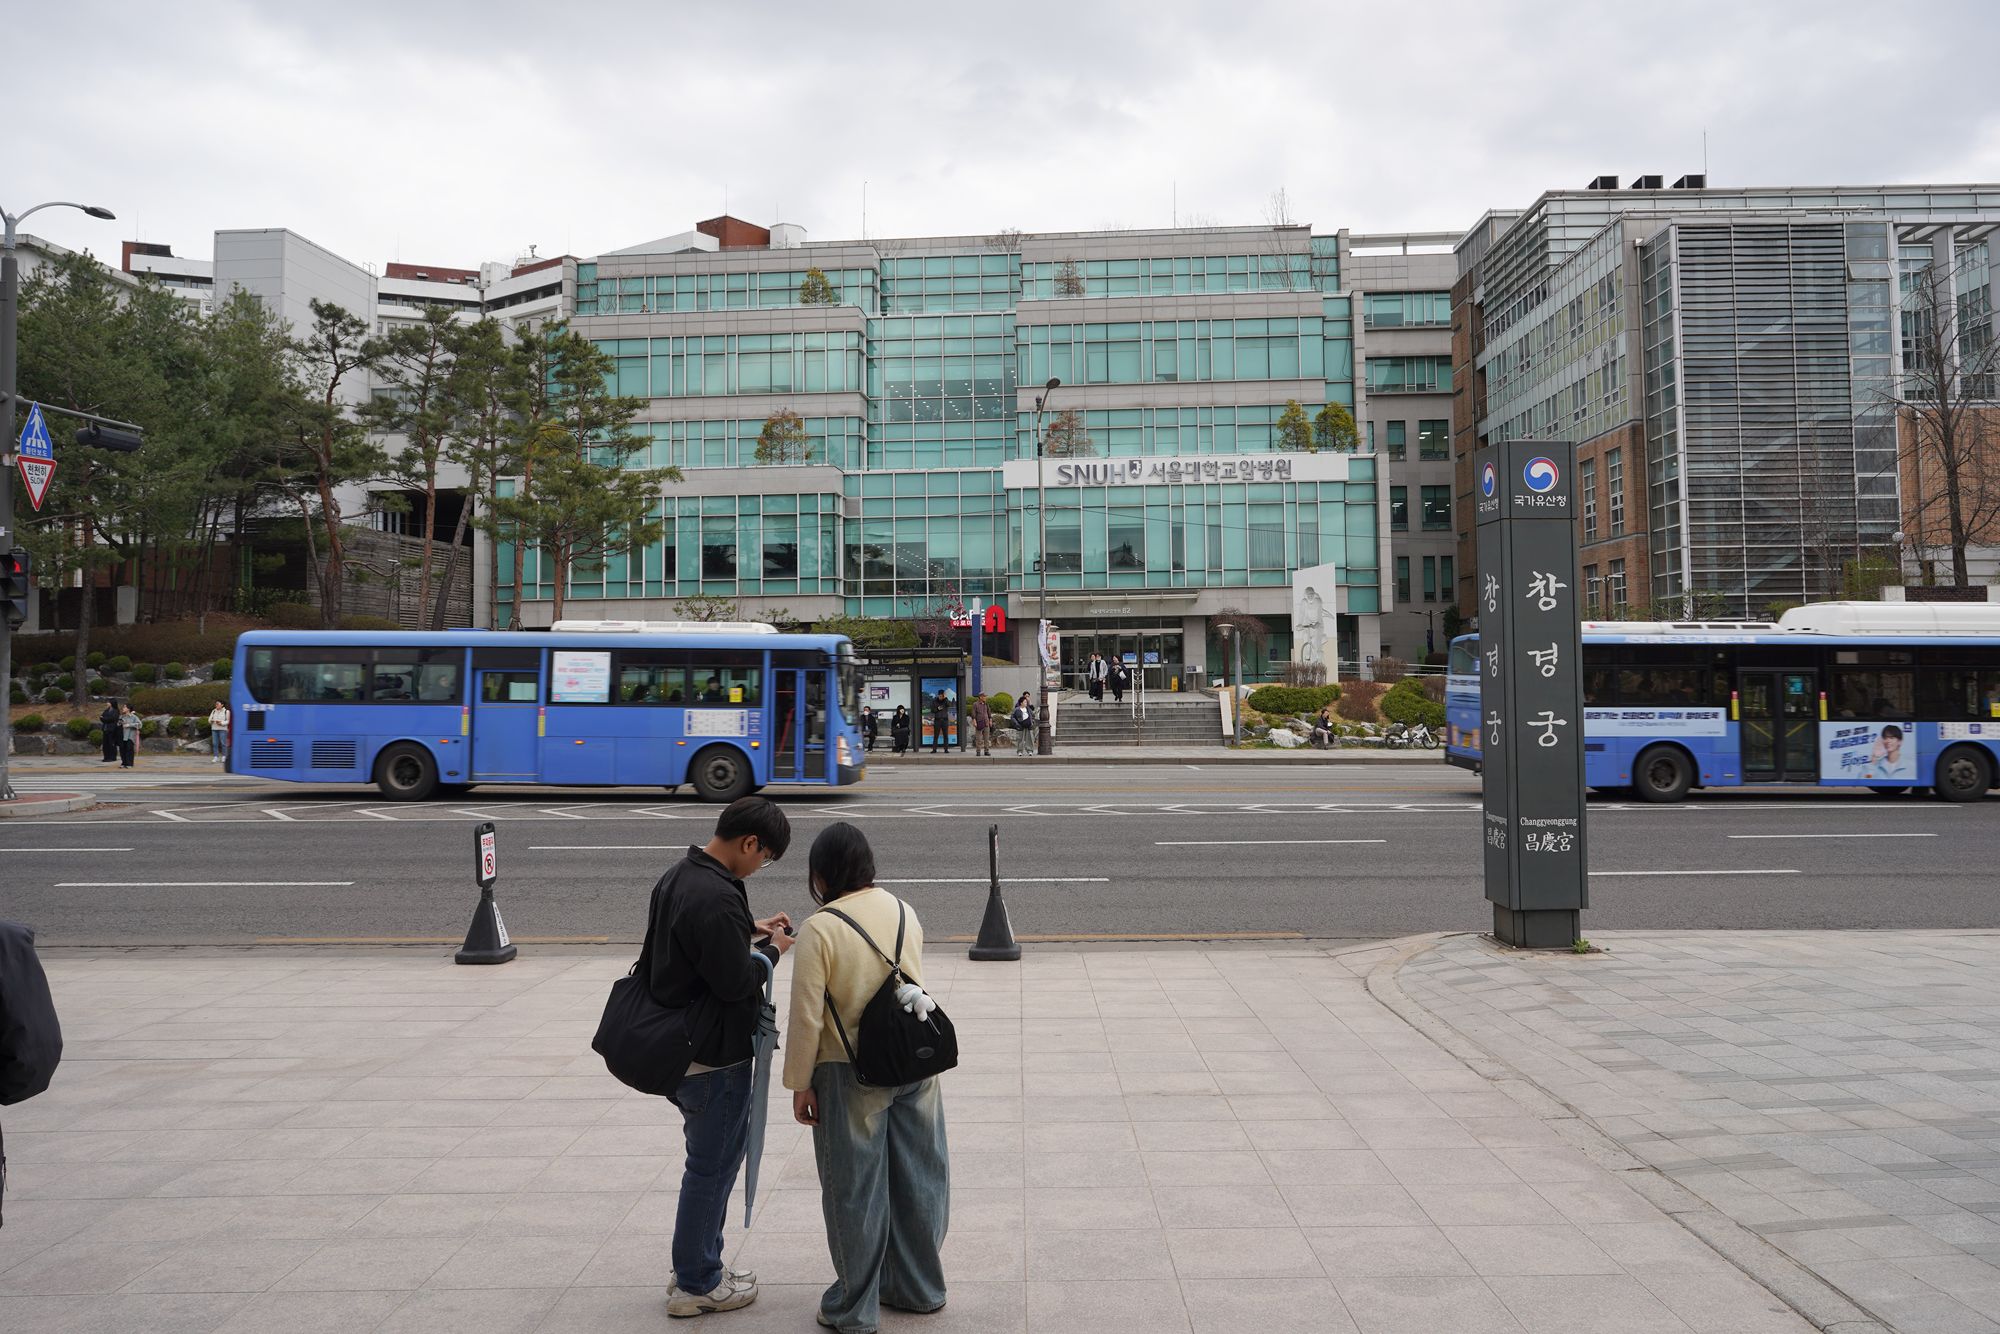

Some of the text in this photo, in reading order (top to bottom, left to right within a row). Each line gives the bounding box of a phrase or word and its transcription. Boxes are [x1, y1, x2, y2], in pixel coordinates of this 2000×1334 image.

[28, 464, 47, 477] 천천히
[1057, 459, 1292, 485] SNUH 서울대학교암병원
[1514, 495, 1567, 507] 국가유산청
[1526, 570, 1568, 747] 창경궁
[1520, 816, 1578, 827] Changgyeonggung
[1525, 831, 1573, 852] 昌慶宮
